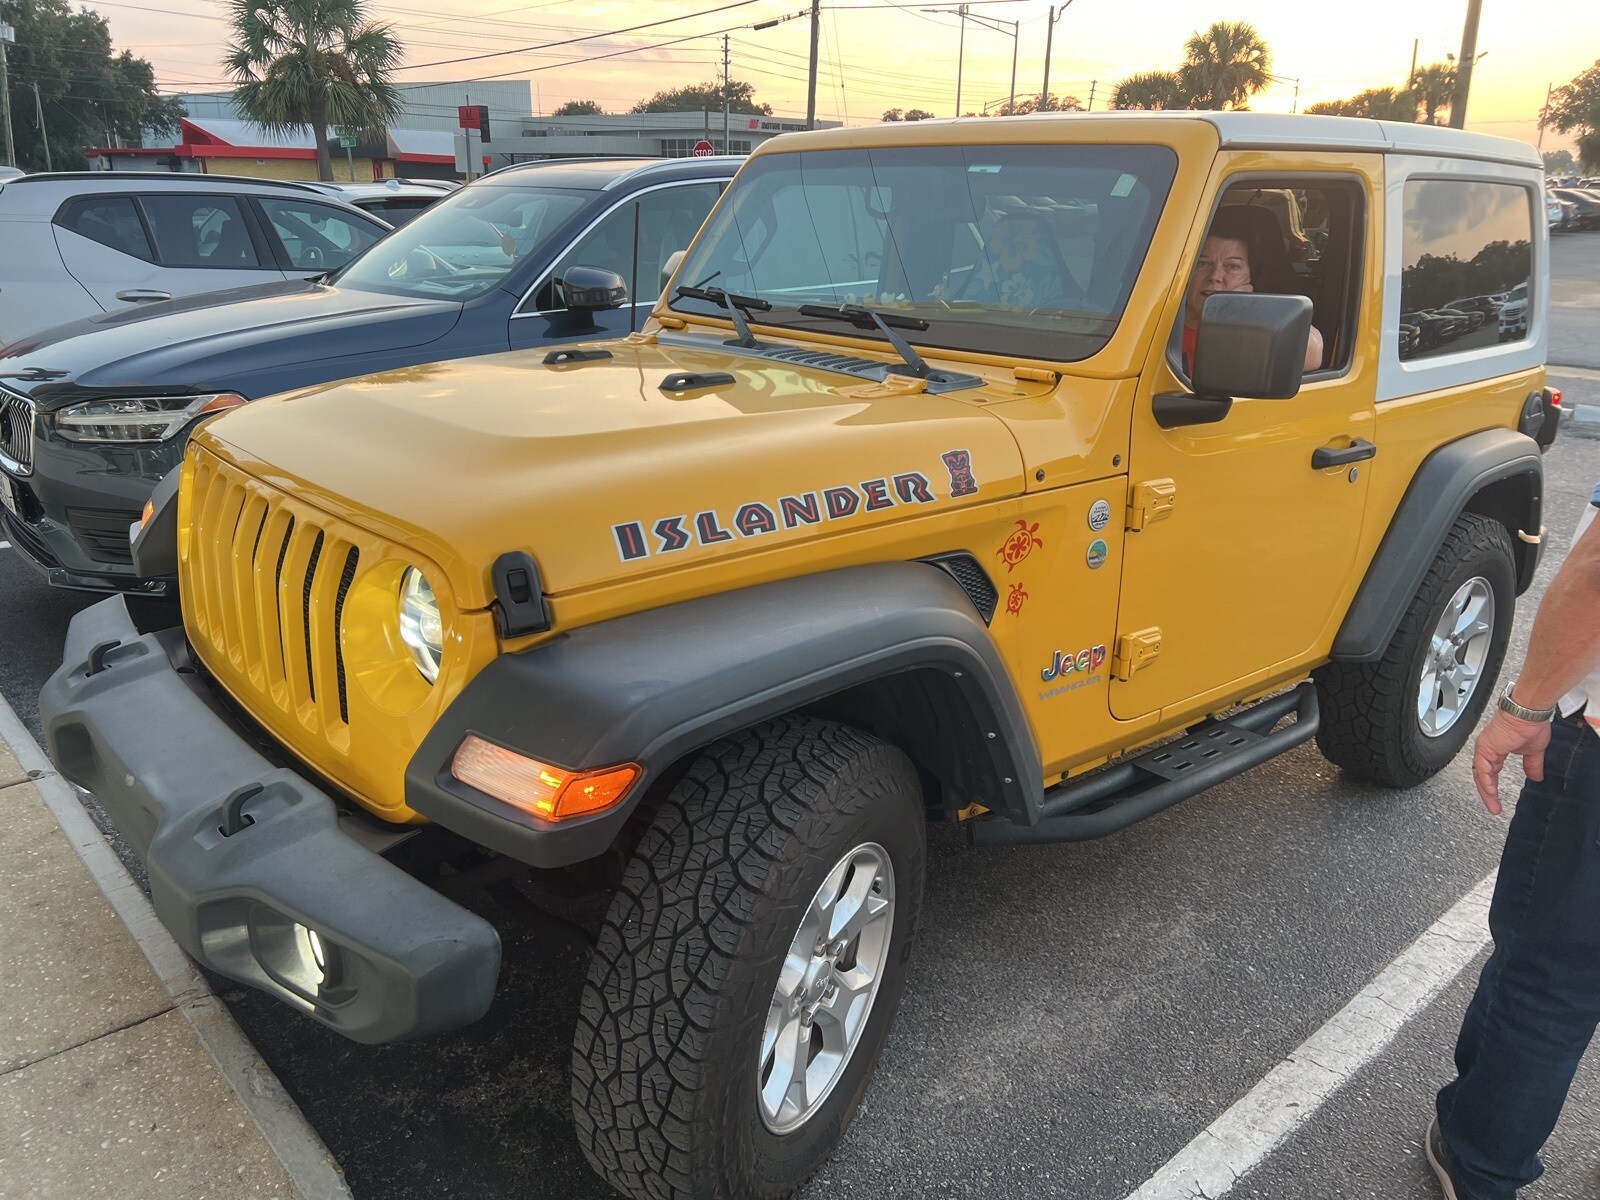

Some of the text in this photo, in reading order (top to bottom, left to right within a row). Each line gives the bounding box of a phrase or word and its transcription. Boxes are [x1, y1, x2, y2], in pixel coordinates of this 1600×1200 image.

[694, 149, 713, 157] STOP
[611, 471, 935, 562] ISLANDER
[1041, 644, 1107, 682] Jeep
